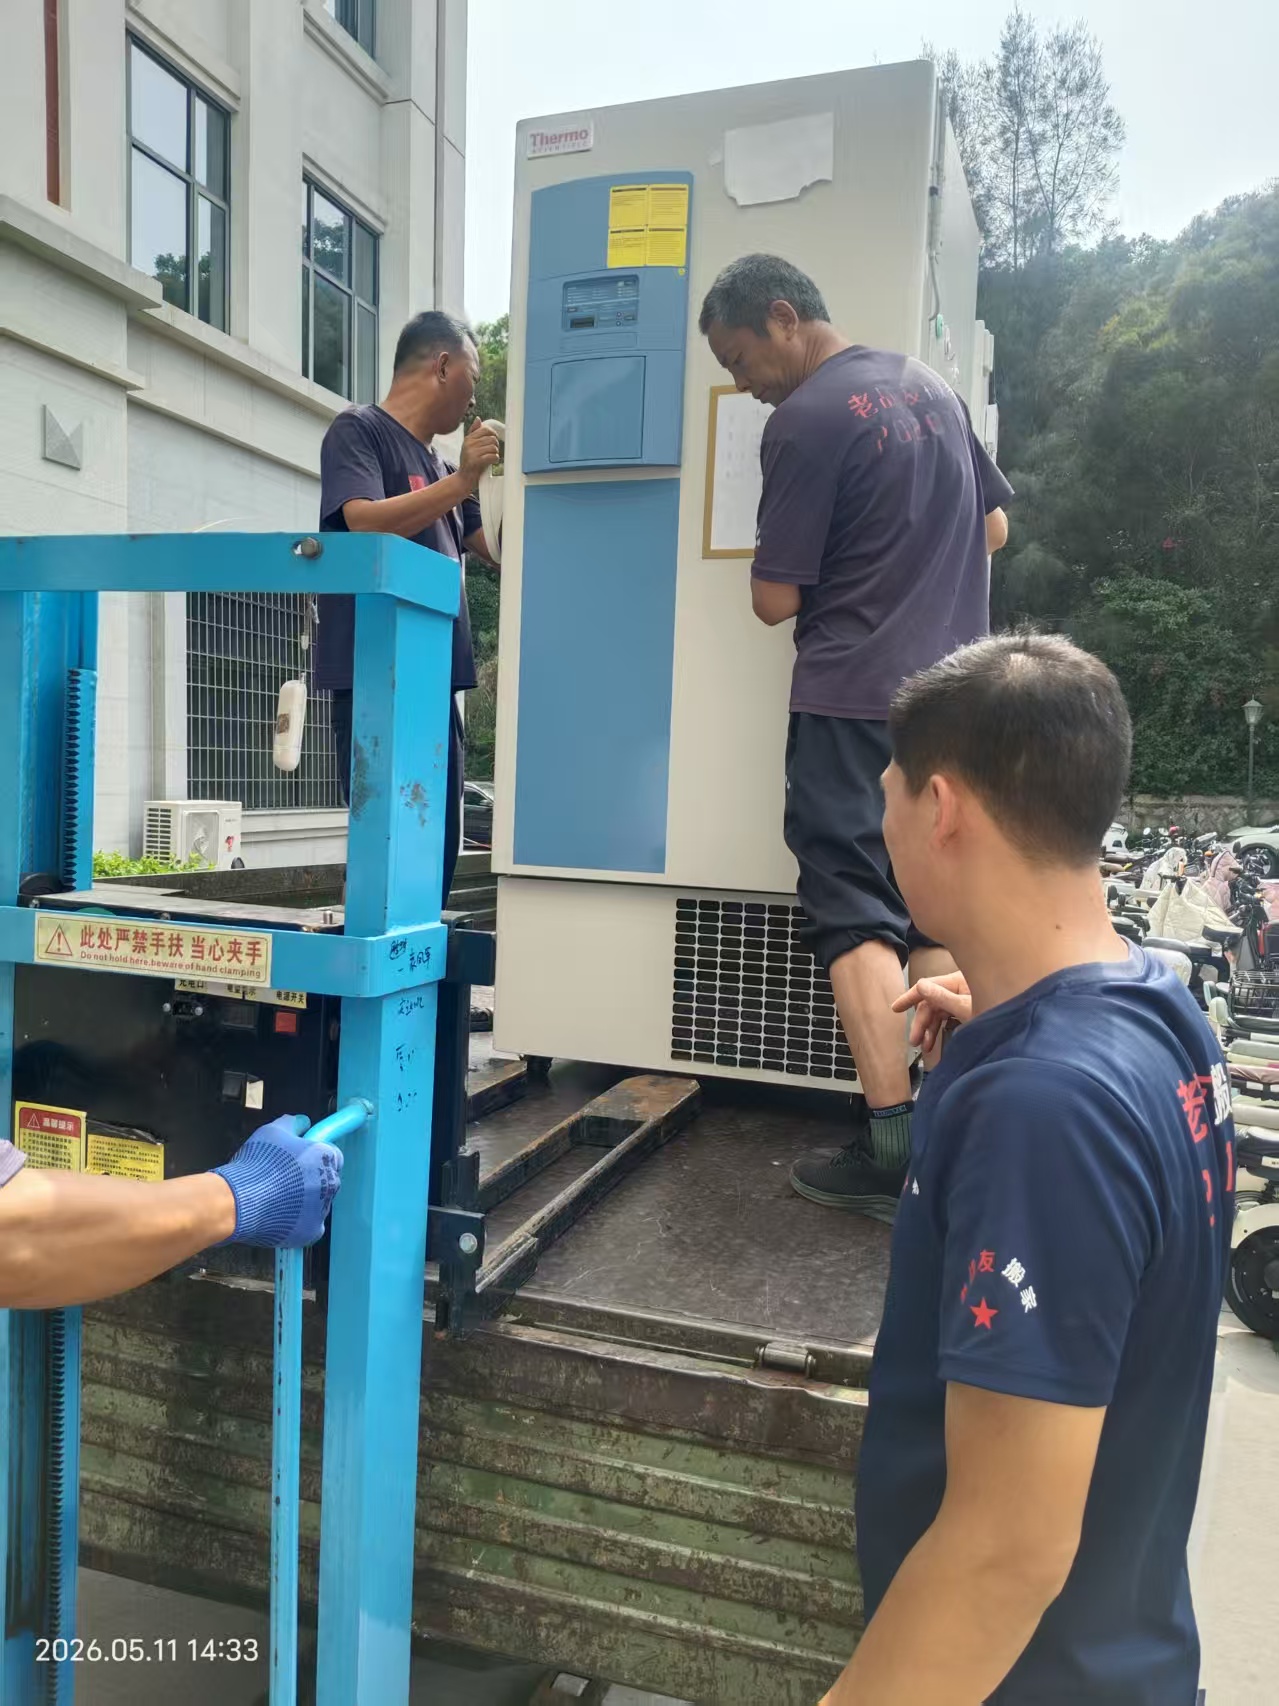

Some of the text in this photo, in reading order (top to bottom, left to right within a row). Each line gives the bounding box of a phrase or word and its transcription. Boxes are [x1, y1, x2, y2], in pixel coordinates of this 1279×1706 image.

[529, 129, 589, 147] Thermo
[80, 924, 263, 967] 此处严禁手扶 当心夹手
[80, 950, 92, 960] Do
[93, 953, 107, 961] not
[109, 953, 128, 963] hold
[184, 962, 194, 970] of
[195, 963, 218, 973] hand
[219, 966, 261, 979] clamping
[275, 990, 305, 1004] 电源开关
